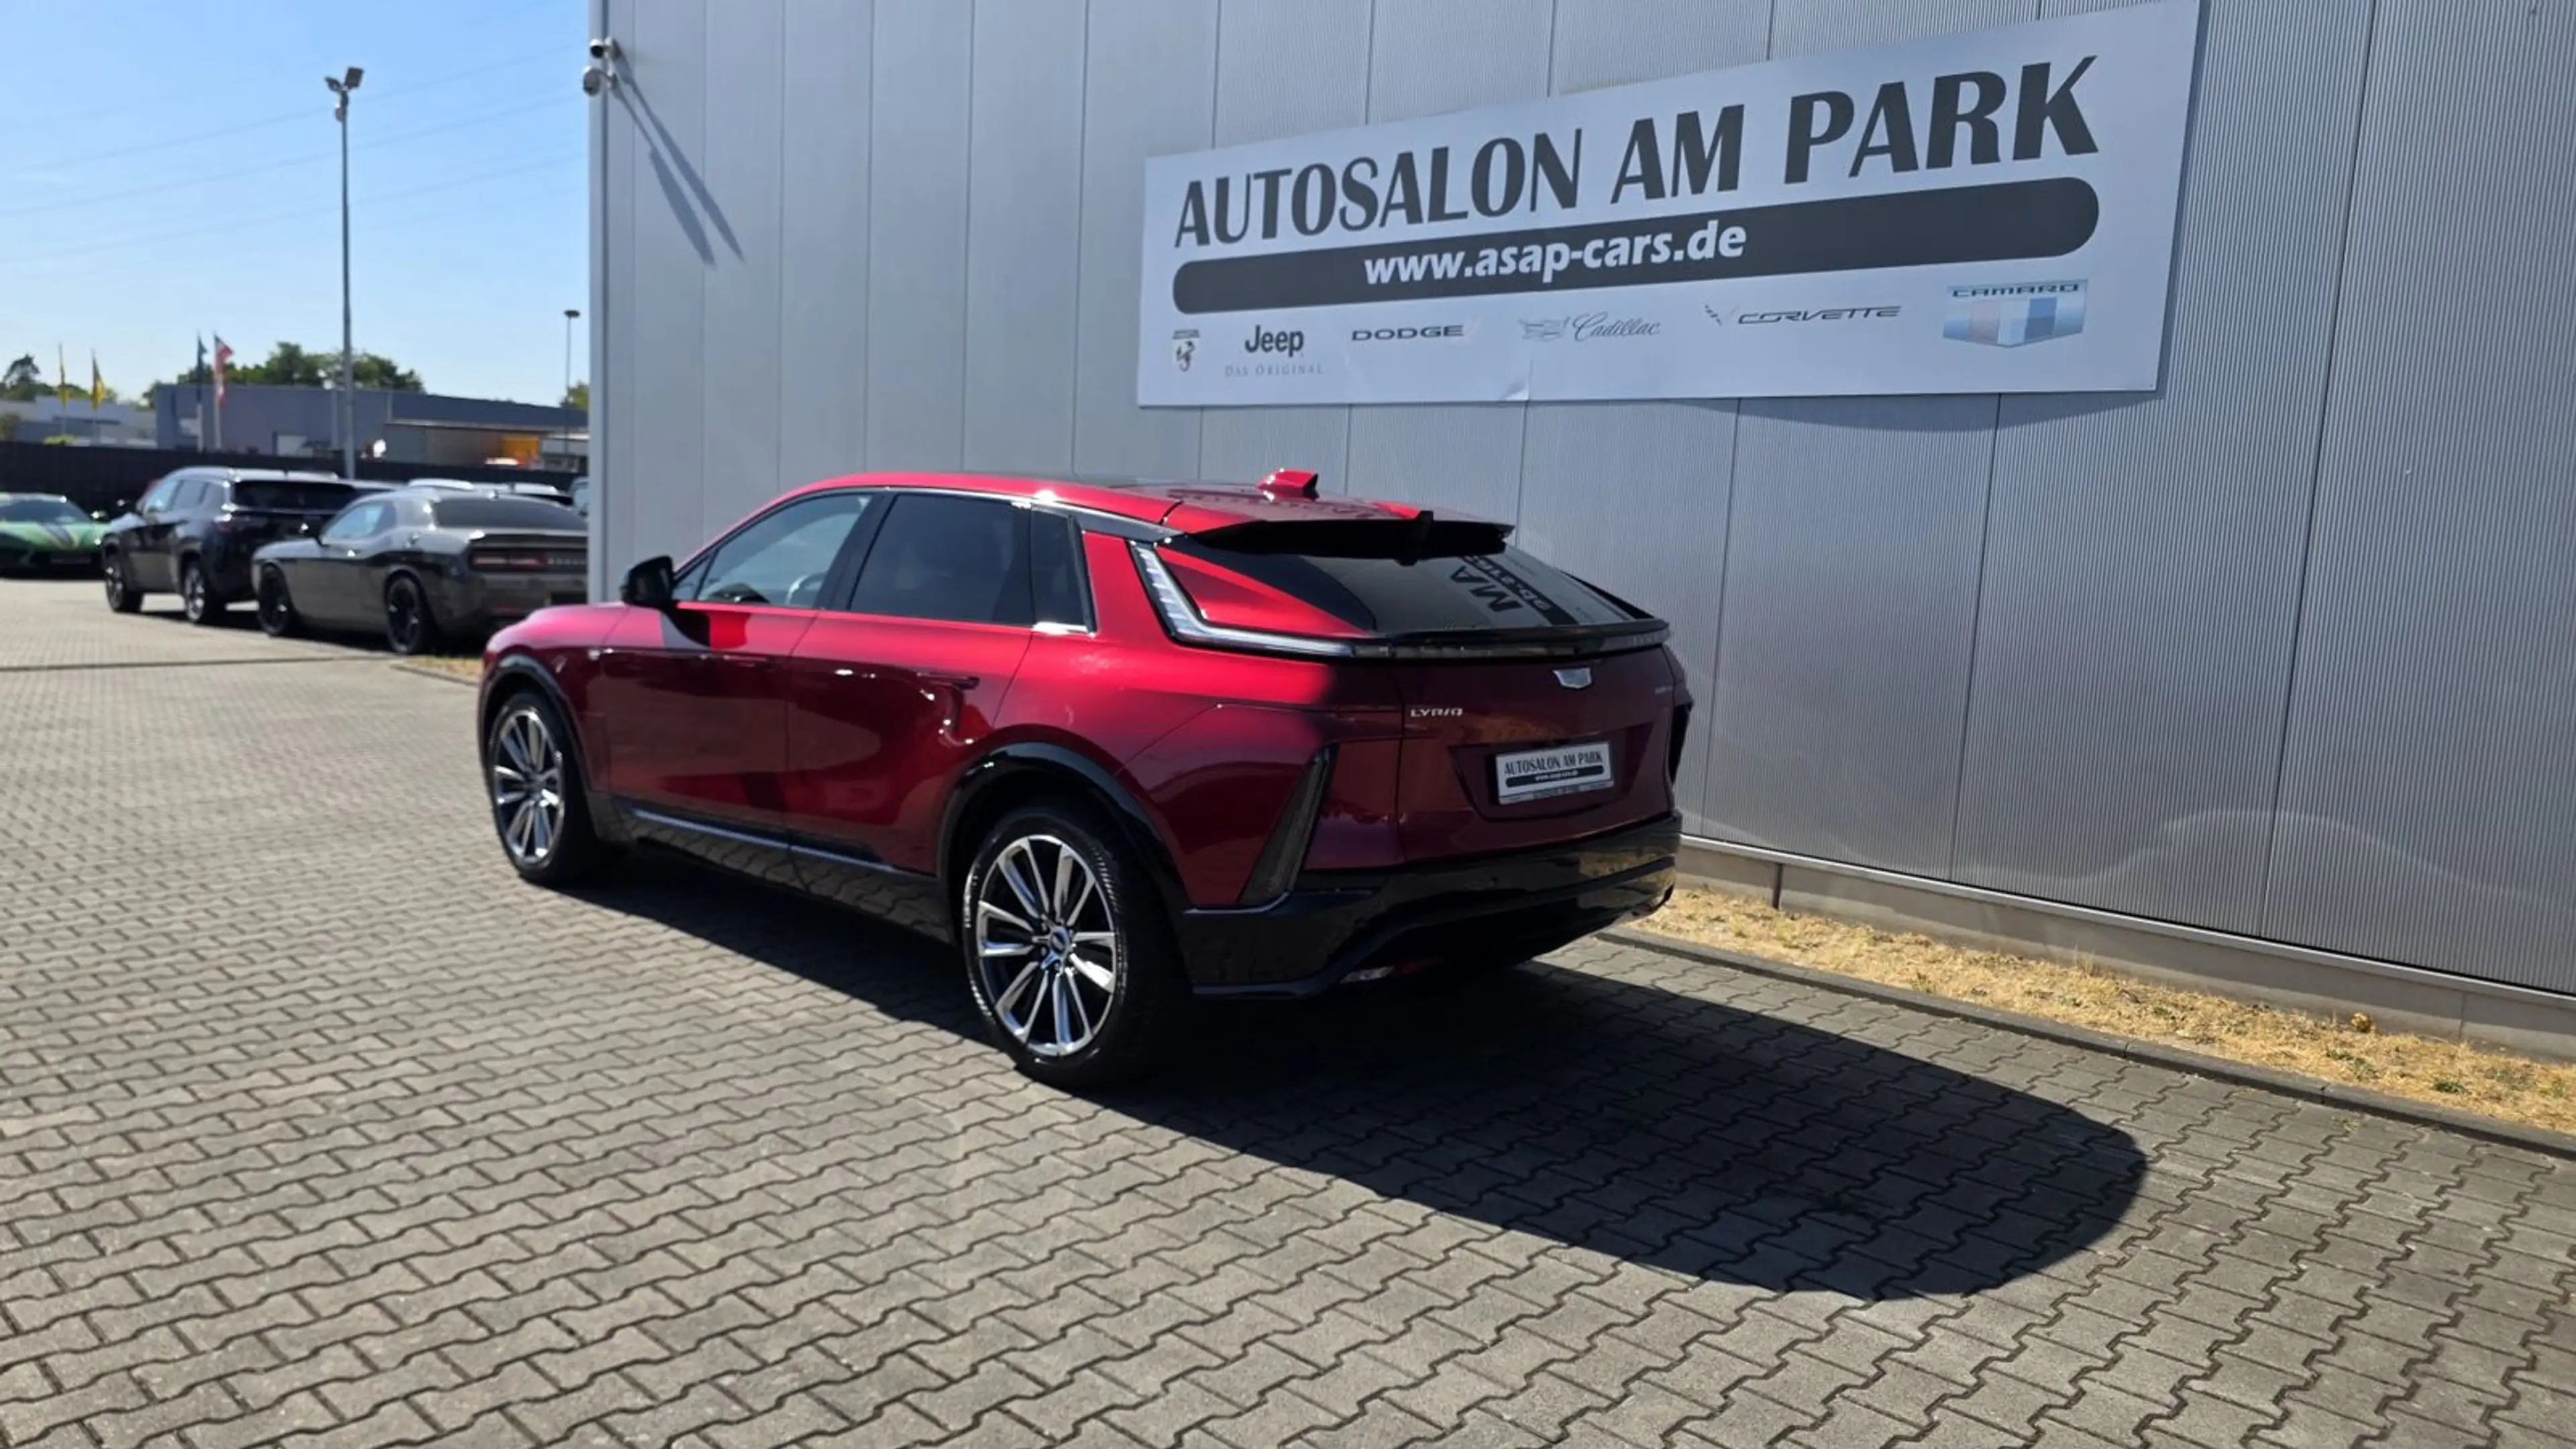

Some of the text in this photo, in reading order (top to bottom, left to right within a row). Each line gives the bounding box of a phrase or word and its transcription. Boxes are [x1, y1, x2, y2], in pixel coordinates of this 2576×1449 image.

[1175, 55, 2098, 248] AUTOSALON AM PARK
[1364, 220, 1746, 284] www.asap-cars.de
[1952, 283, 2078, 297] CAMARO
[1572, 311, 1660, 342] Cadillac
[1738, 306, 1902, 324] CORVETTE
[1245, 324, 1304, 358] Jeep
[1352, 325, 1464, 341] DODGE
[1505, 755, 1561, 775] AUTOSALON
[1578, 750, 1603, 765] PARK
